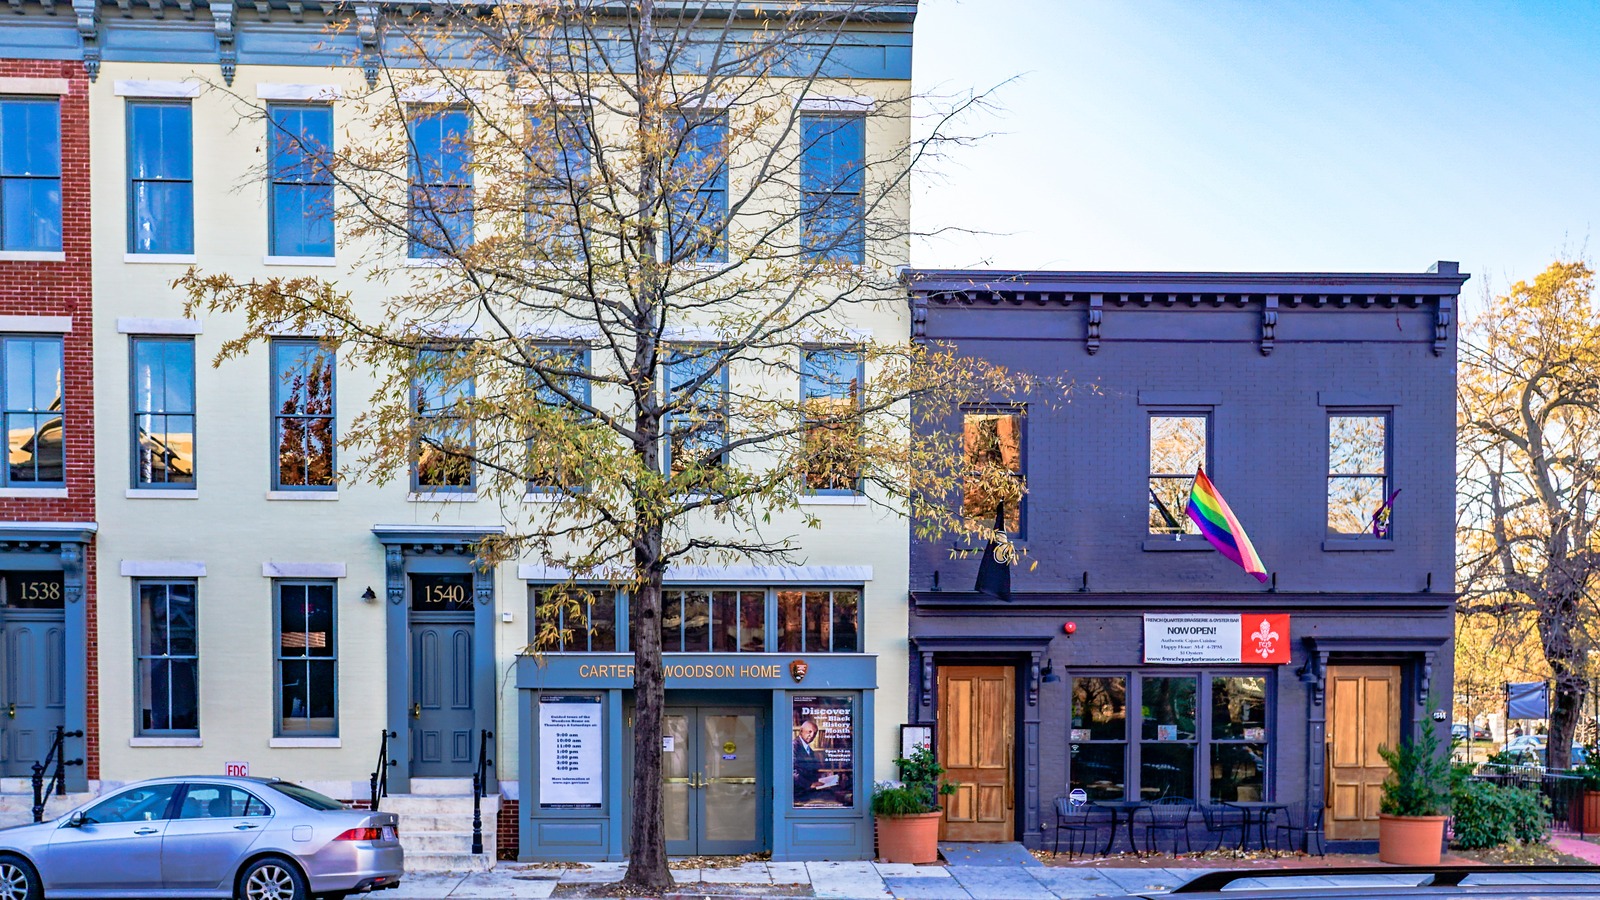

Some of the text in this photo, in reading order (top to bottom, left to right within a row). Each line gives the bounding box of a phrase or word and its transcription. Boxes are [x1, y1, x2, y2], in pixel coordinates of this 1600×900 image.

[21, 582, 60, 600] 1538
[425, 585, 465, 602] 1540
[1167, 626, 1217, 635] NOW OPEN!
[580, 664, 781, 678] CARTER WOODSON HOME
[227, 764, 247, 777] FDC
